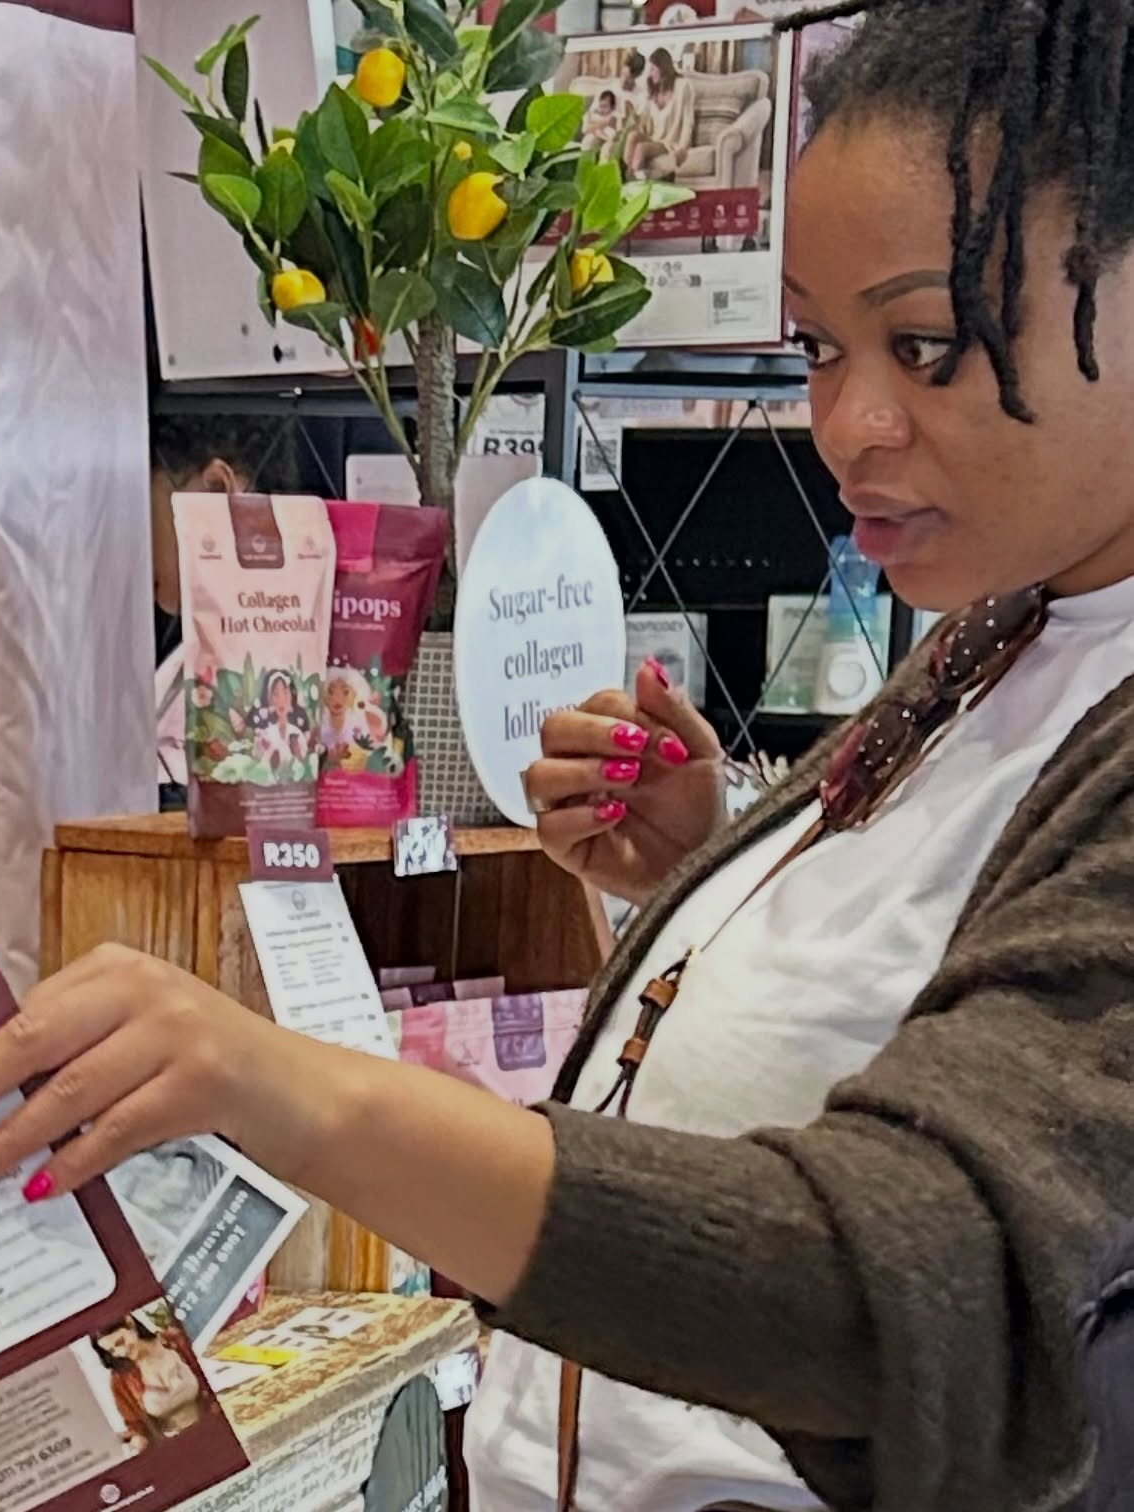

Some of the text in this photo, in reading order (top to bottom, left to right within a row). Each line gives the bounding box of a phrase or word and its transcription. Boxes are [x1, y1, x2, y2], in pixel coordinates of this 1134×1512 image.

[237, 591, 301, 611] Collagen
[334, 590, 401, 621] ipops
[488, 574, 593, 624] Sugar-free
[221, 618, 249, 634] Hot
[503, 641, 584, 680] collagen
[263, 842, 320, 868] R350
